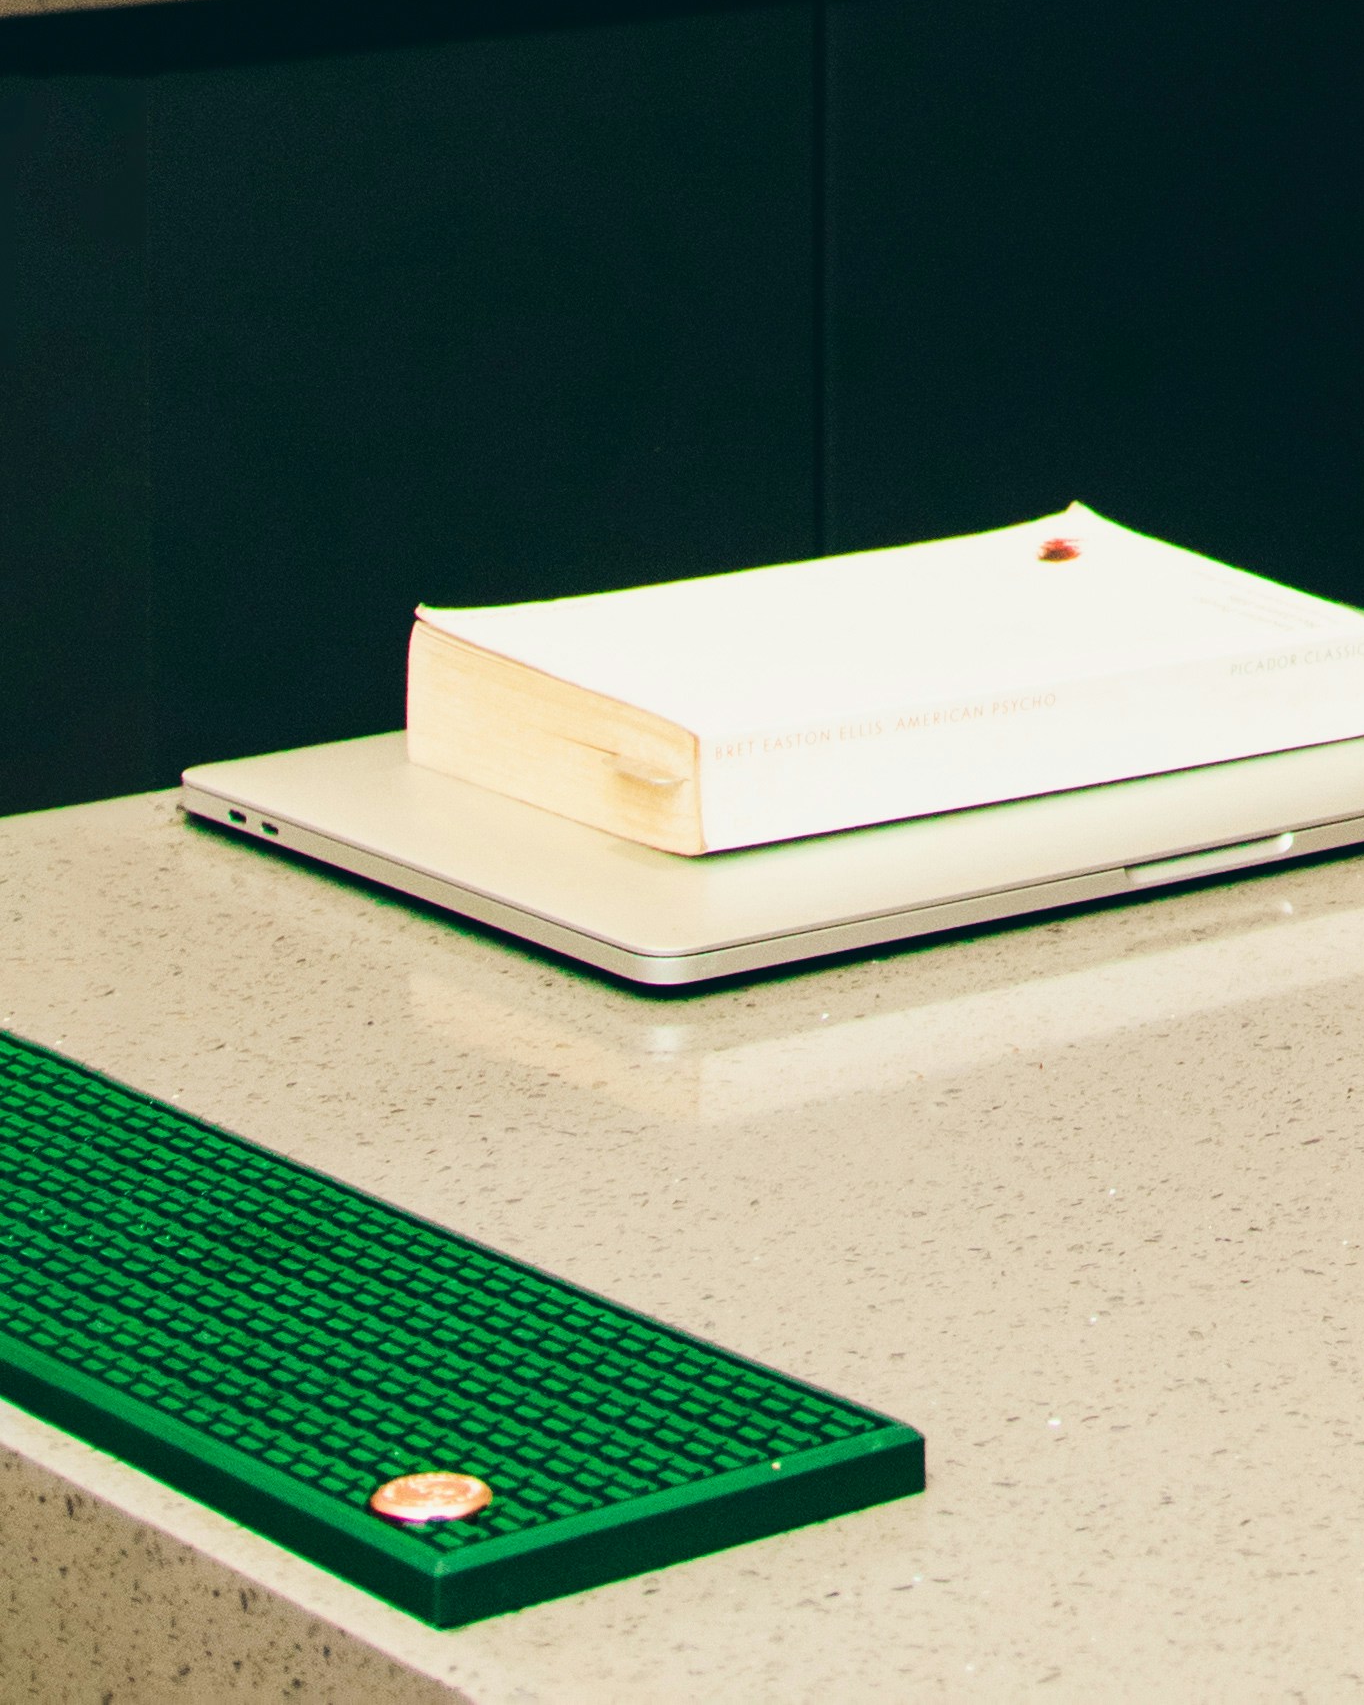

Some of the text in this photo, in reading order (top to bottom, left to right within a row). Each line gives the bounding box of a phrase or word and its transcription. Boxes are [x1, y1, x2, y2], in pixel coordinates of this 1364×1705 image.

[1229, 652, 1298, 677] PICADOR
[714, 691, 1057, 761] BRET EASTON ELLIS AMERICAN PSYCHO
